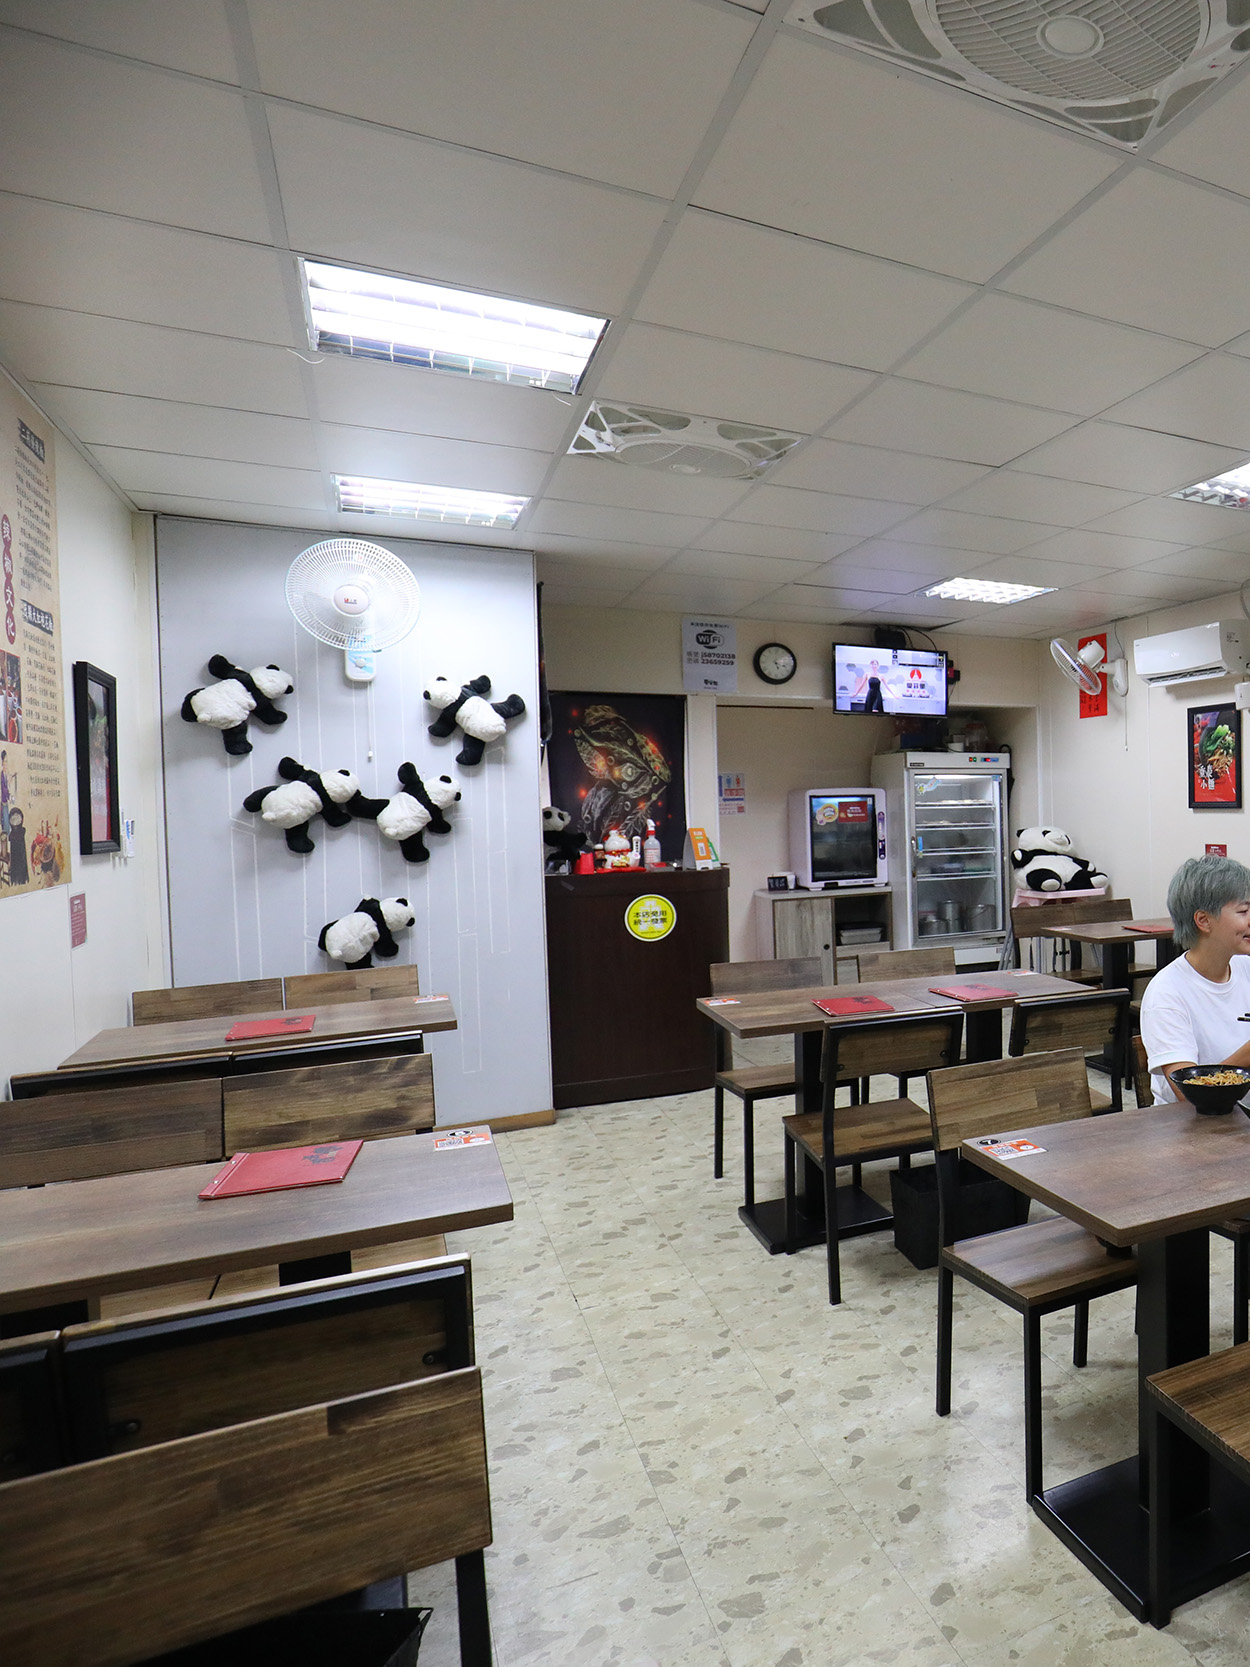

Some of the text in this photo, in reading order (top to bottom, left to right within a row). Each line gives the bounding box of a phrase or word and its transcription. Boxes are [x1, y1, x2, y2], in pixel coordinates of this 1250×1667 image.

[2, 520, 16, 638] 辣椒文化
[633, 910, 667, 918] 本店免用
